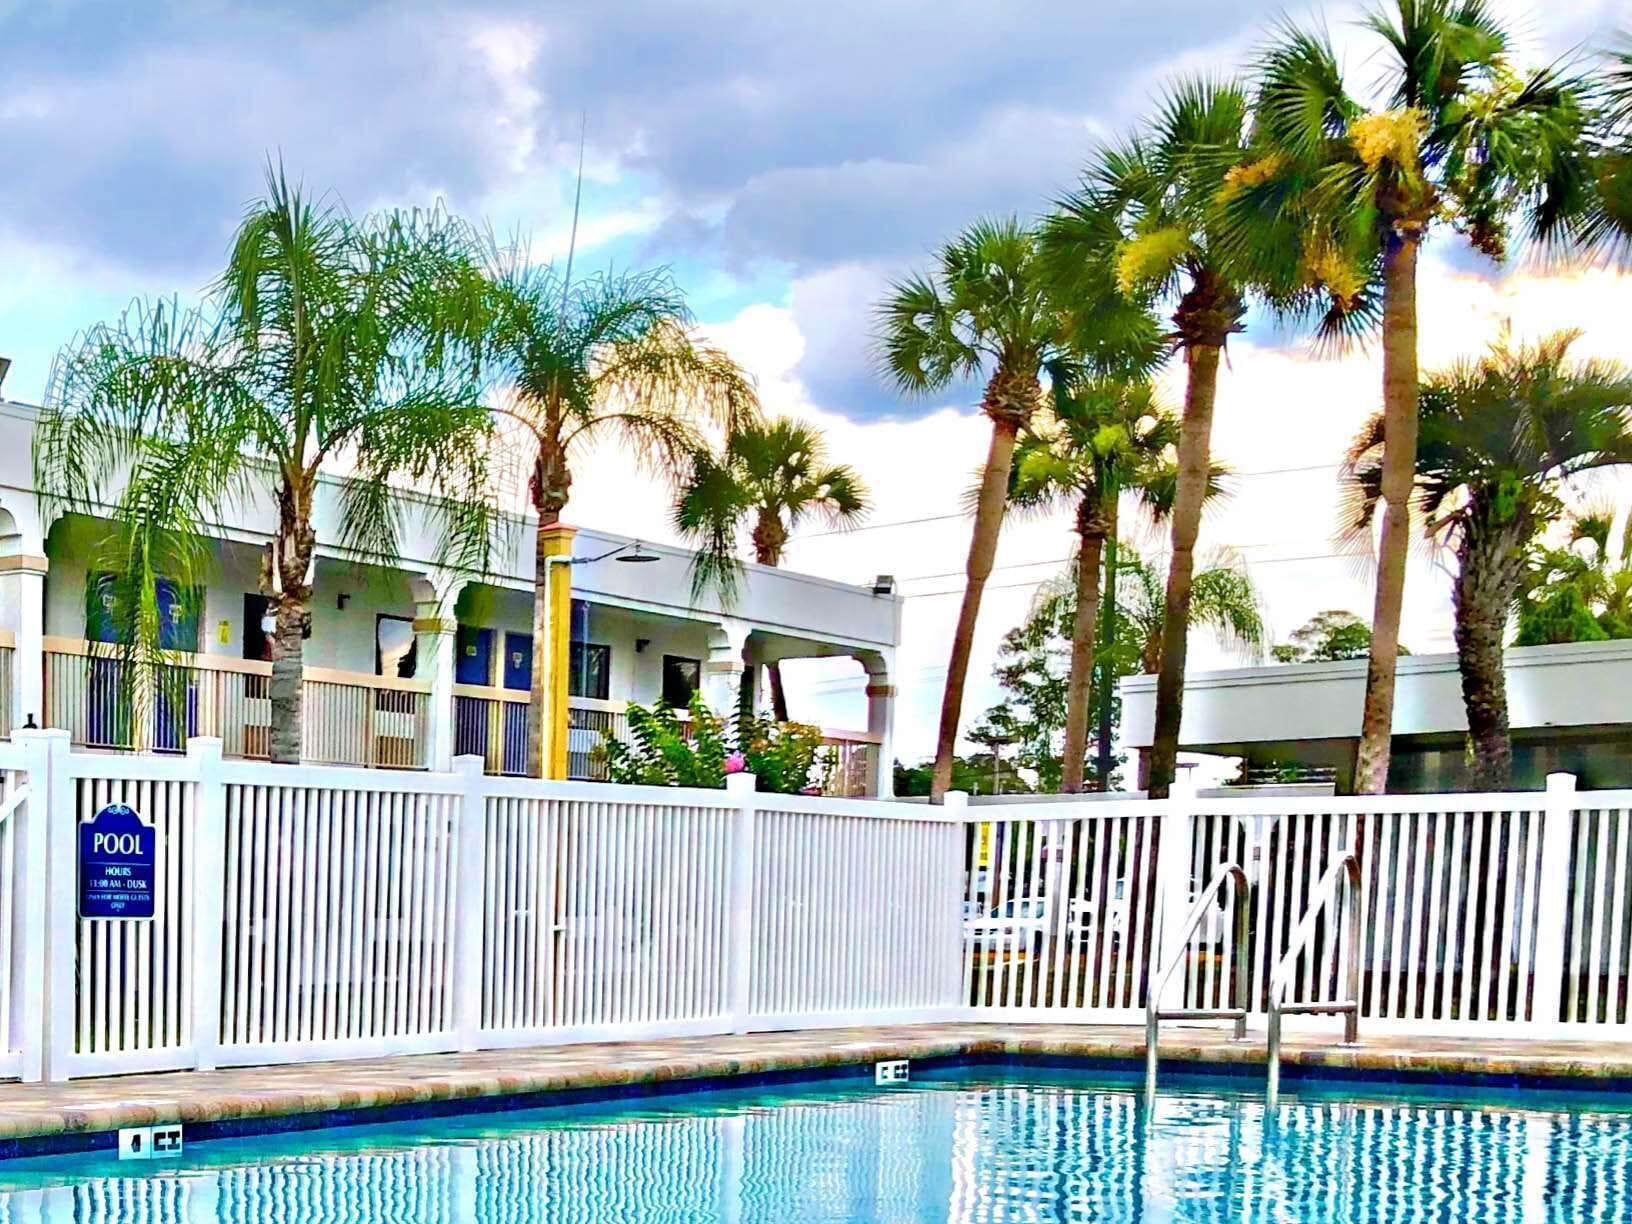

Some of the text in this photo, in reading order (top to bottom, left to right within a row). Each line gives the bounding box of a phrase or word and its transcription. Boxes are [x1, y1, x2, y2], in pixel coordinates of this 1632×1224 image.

[93, 833, 144, 855] POOL
[105, 866, 131, 876] HOURS
[109, 879, 121, 888] AM
[127, 879, 147, 889] DUSK
